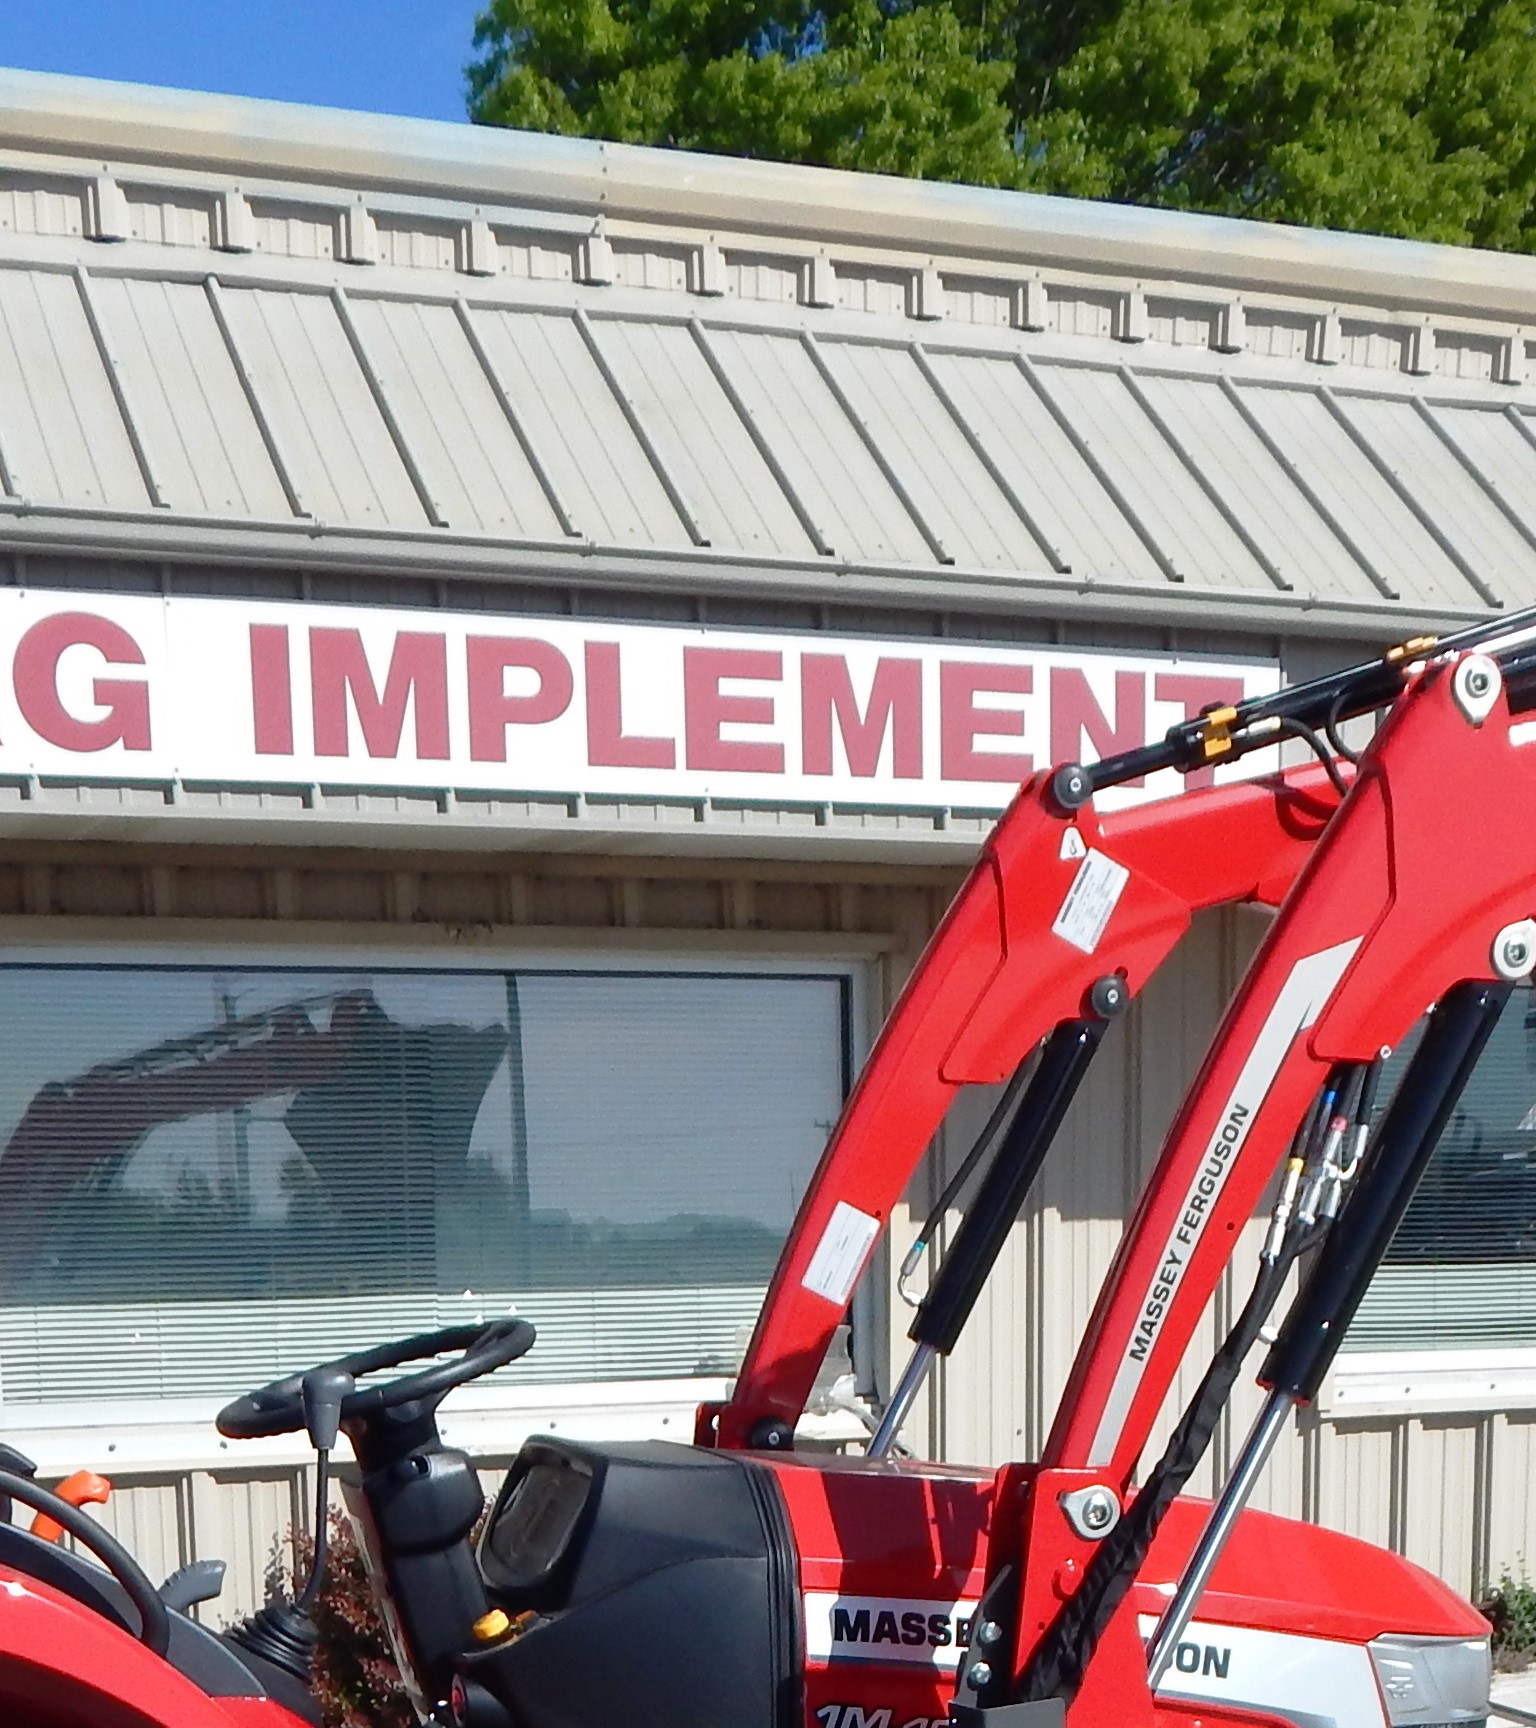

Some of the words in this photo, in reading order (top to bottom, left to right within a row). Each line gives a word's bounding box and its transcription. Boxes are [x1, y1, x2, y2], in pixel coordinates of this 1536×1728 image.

[248, 622, 1245, 793] IMPLEMENT
[1128, 1248, 1183, 1362] MASSEY
[1176, 1103, 1250, 1245] FERGUSON
[833, 1608, 971, 1648] MASSE
